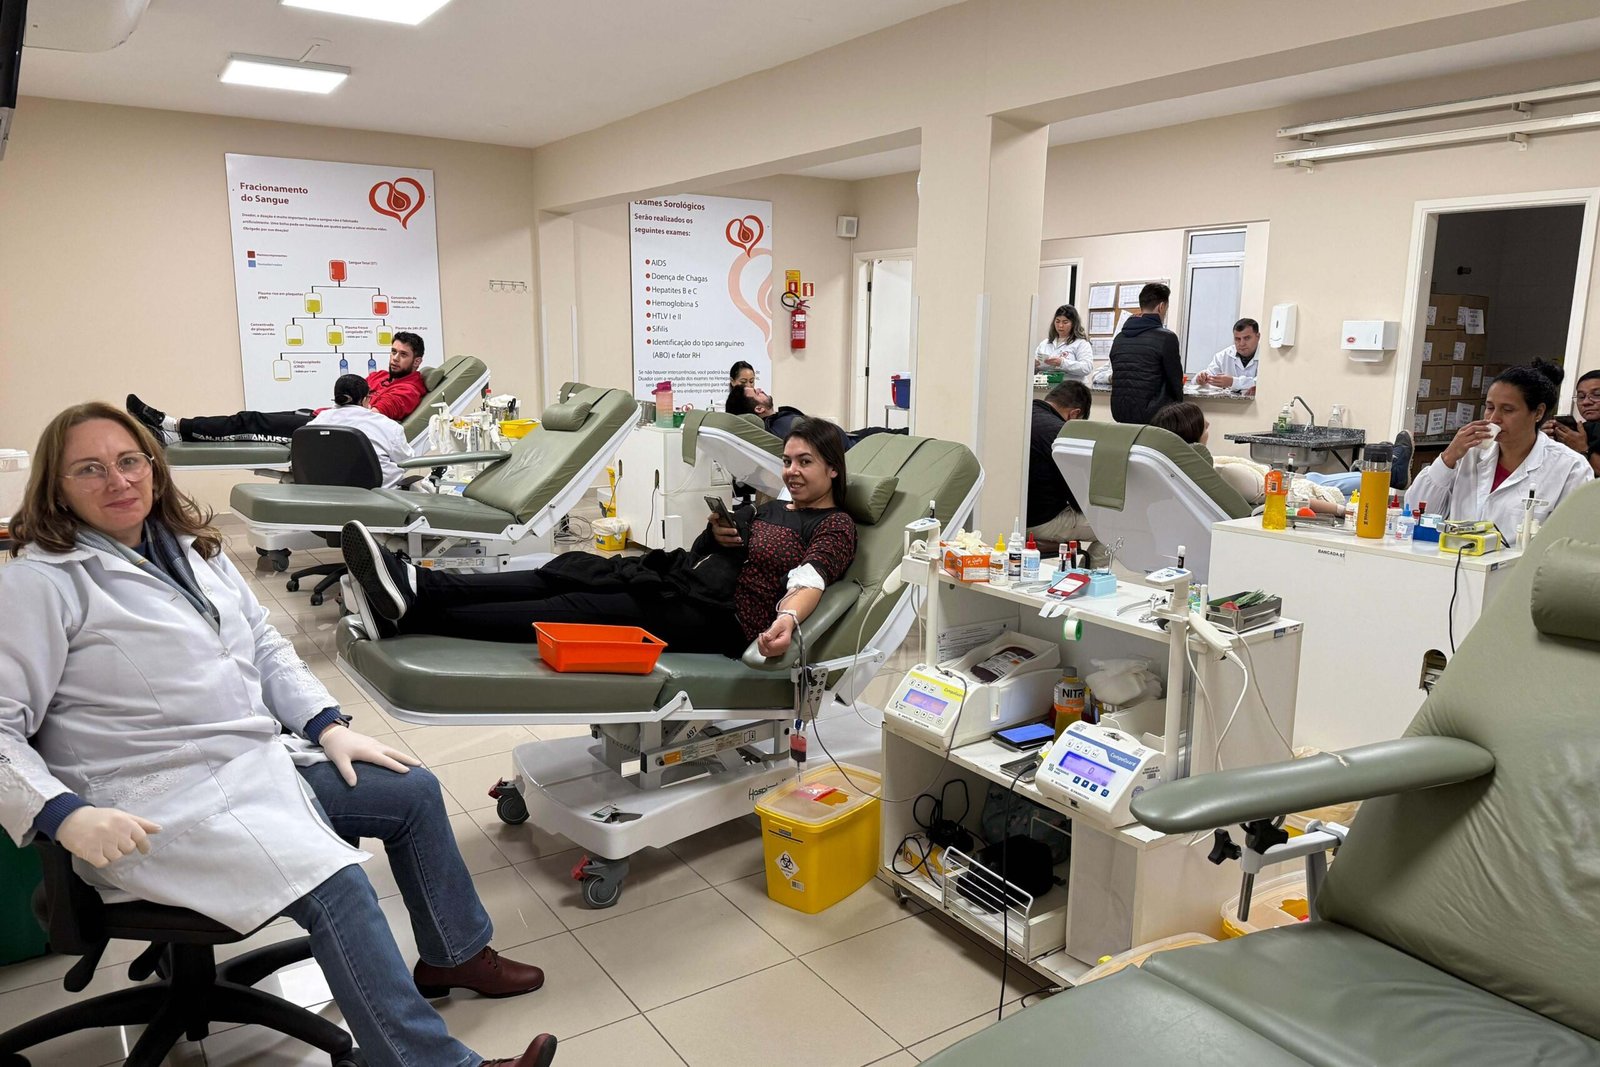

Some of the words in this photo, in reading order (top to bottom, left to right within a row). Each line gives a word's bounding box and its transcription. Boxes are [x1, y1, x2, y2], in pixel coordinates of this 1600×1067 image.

[240, 182, 308, 194] Fracionamento
[255, 195, 289, 205] Sangue
[664, 200, 705, 211] Sorológicos
[654, 215, 685, 223] realizados
[634, 227, 665, 235] seguintes
[652, 273, 675, 282] Doença
[686, 275, 708, 283] Chagas
[652, 287, 681, 295] Hepatites
[652, 300, 694, 308] Hemoglobina
[652, 339, 691, 347] Identificação
[701, 340, 714, 348] tipo
[252, 434, 288, 443] ANJUSS
[686, 726, 697, 739] 497
[1110, 753, 1136, 766] CompuGuard
